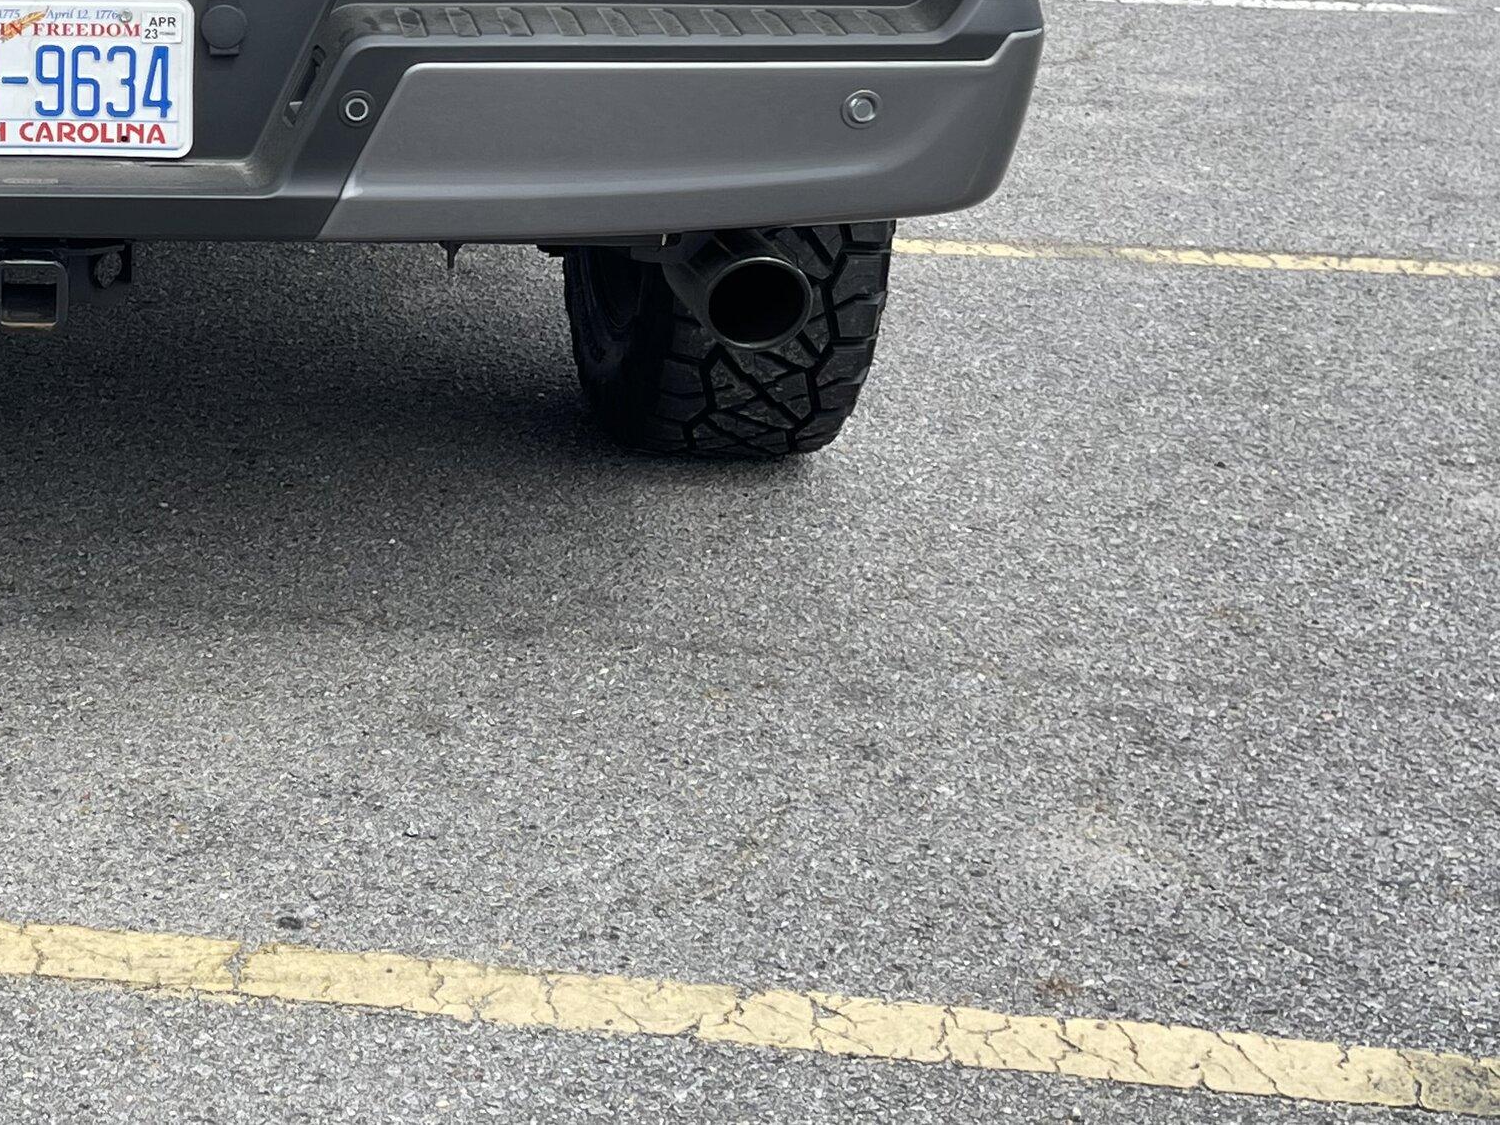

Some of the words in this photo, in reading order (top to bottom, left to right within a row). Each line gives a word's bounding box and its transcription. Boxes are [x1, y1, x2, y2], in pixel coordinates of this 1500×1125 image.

[46, 8, 74, 22] April
[95, 9, 119, 20] 1776
[149, 16, 176, 27] APR
[0, 21, 24, 36] IN
[32, 22, 141, 37] FREEDOM
[144, 28, 158, 39] 23
[18, 122, 166, 145] CAROLINA
